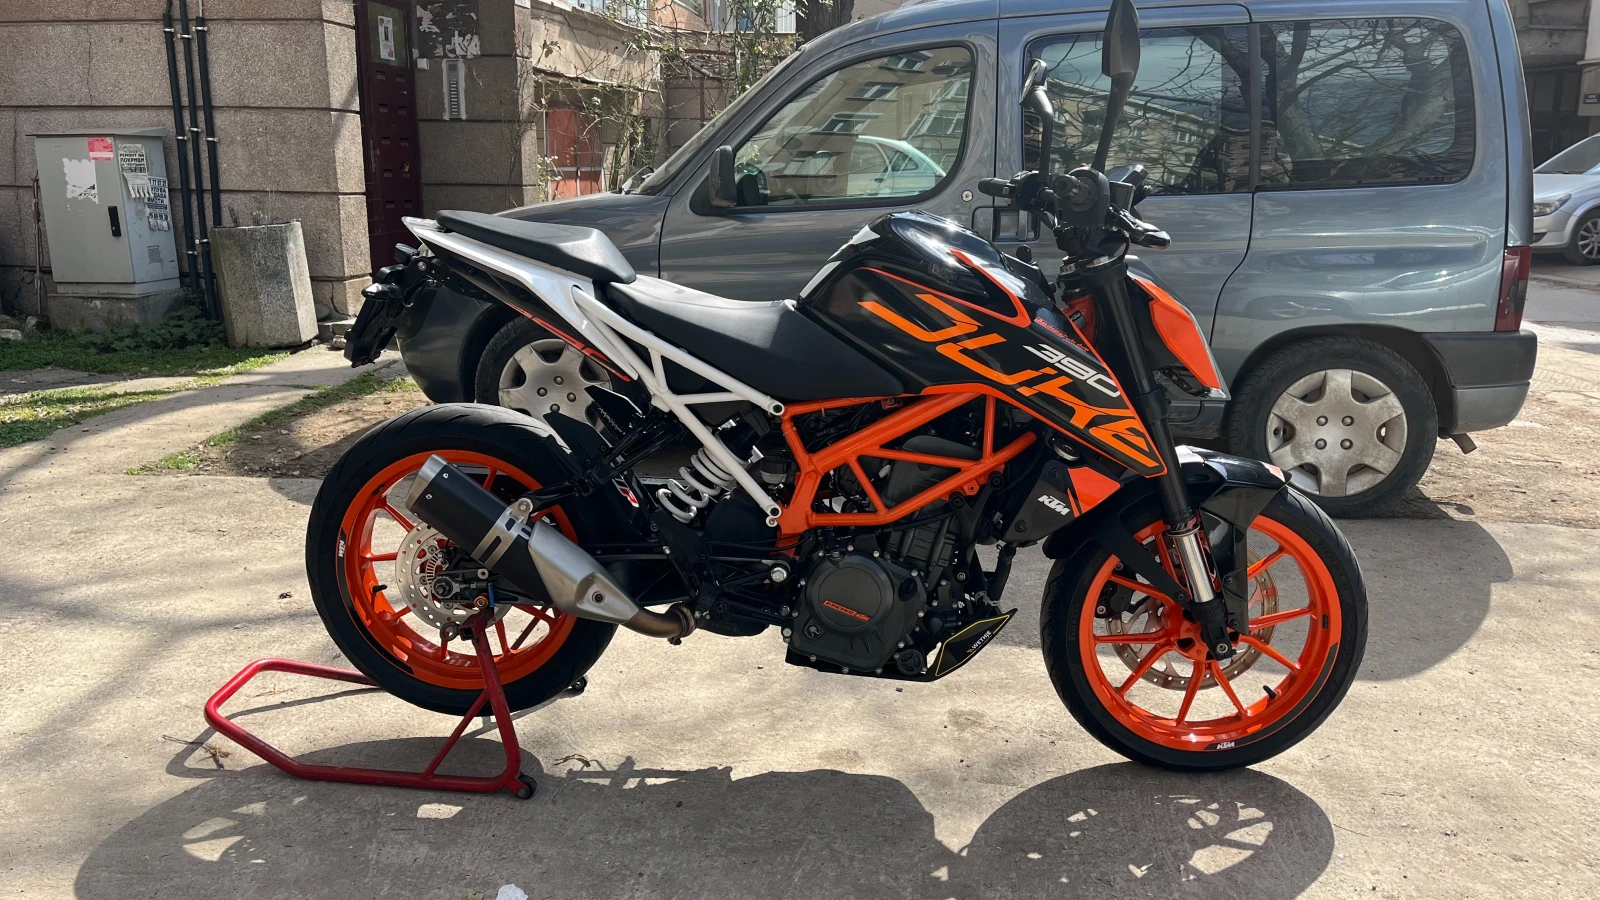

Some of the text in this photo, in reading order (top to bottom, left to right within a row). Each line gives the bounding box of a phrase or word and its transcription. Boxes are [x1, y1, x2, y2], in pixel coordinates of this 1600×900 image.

[857, 294, 1160, 467] DUKE
[1022, 344, 1120, 397] 390
[1037, 494, 1070, 515] KTM
[1216, 741, 1235, 749] KTM
